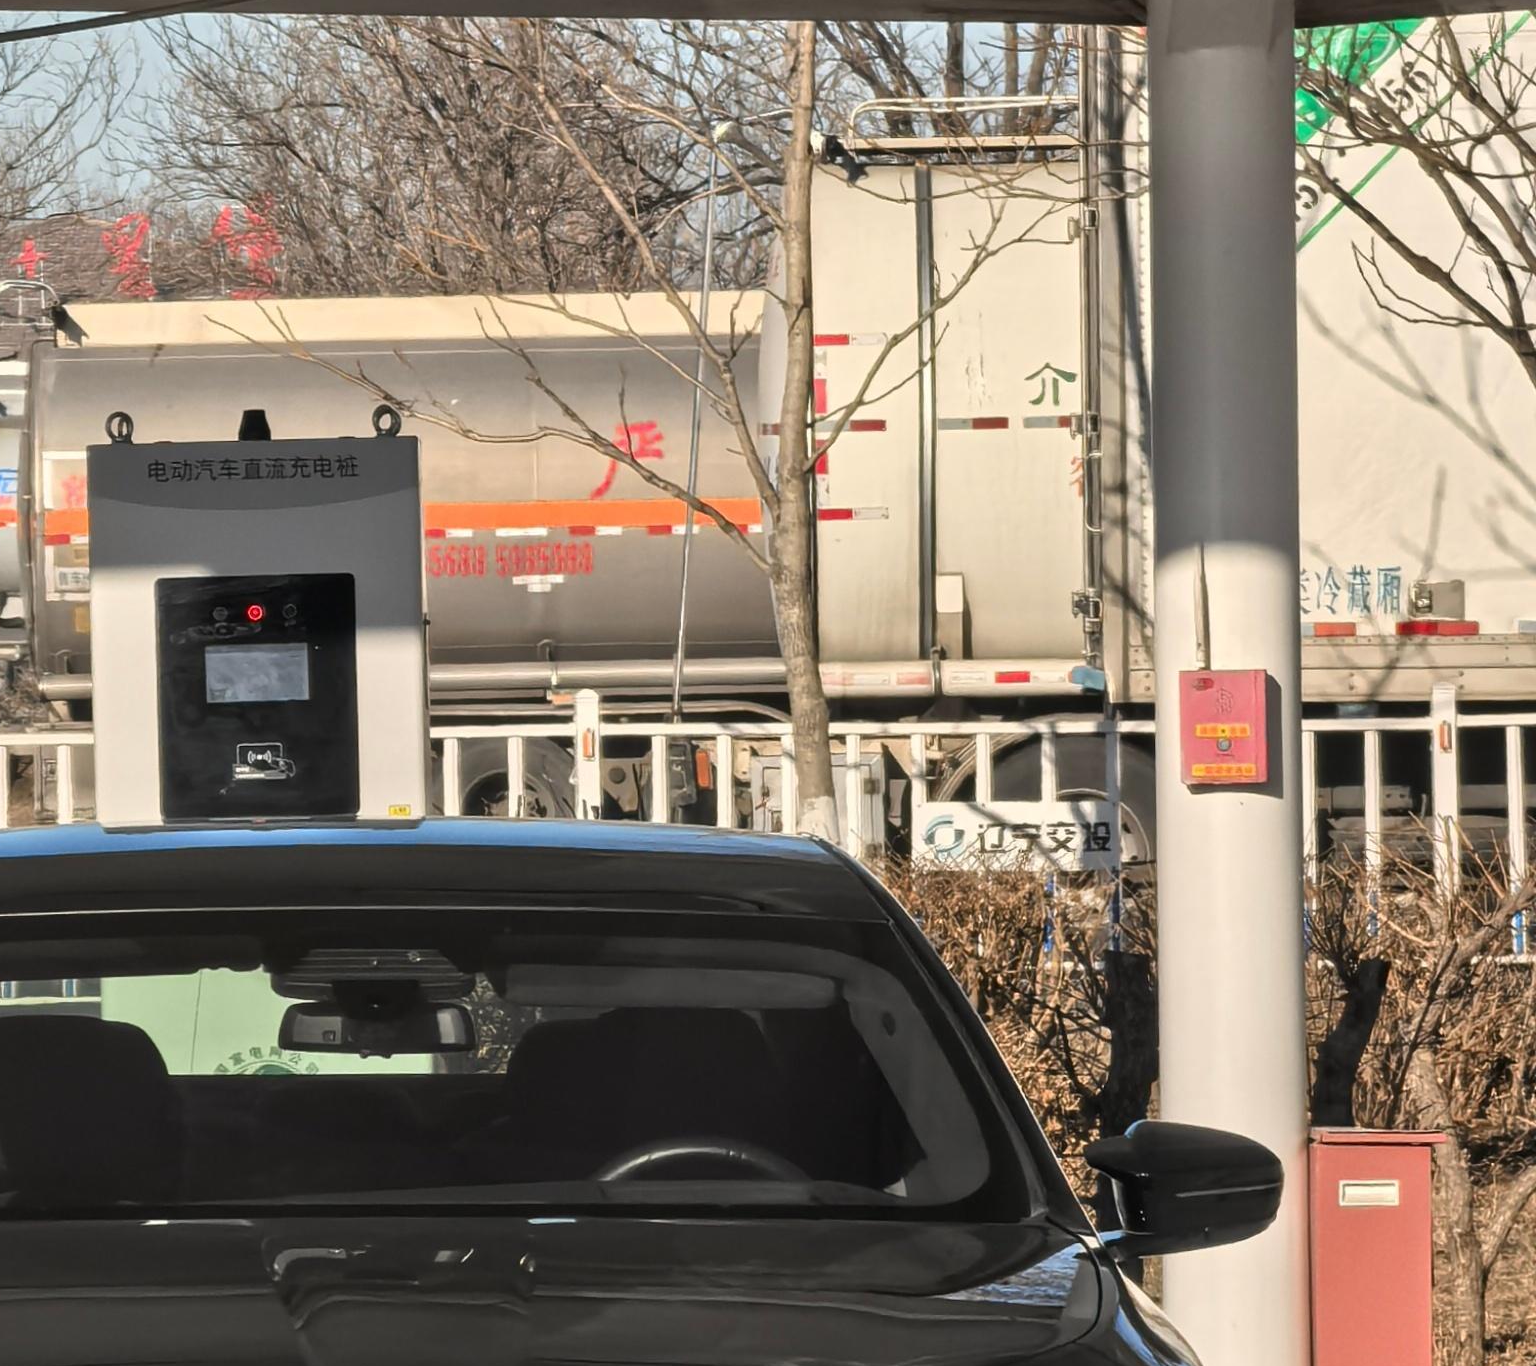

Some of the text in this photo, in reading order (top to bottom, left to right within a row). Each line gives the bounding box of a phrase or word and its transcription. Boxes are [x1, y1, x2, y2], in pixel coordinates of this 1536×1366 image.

[147, 454, 360, 483] 电动汽车直流充电桩
